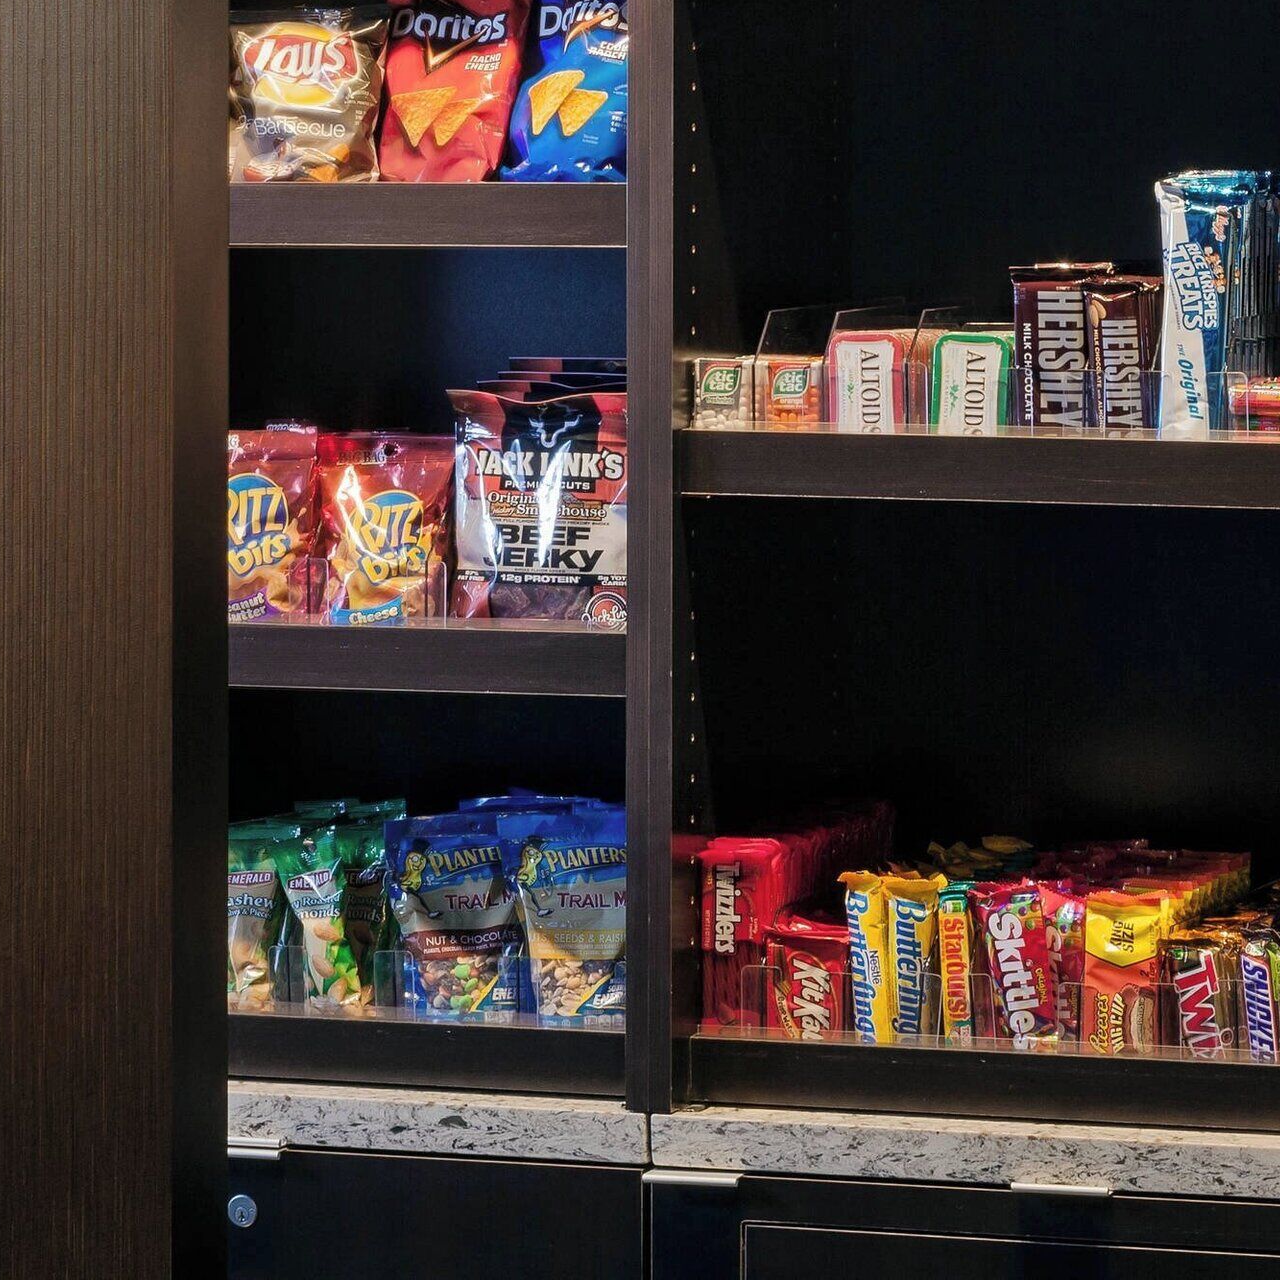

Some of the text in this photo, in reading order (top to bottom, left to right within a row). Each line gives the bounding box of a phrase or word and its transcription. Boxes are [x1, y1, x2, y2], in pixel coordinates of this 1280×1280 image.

[392, 9, 506, 43] Doritos
[464, 61, 502, 72] CHEESE
[469, 52, 502, 64] NACHO
[254, 116, 346, 138] Barbecue
[1170, 241, 1204, 331] TREATS
[1186, 242, 1220, 330] RICE KRISPIES
[1023, 322, 1035, 421] MILK CHOCOLATE
[1037, 290, 1086, 428] HERSHEY
[1101, 319, 1144, 429] HERSHEY
[709, 380, 734, 392] tac
[714, 370, 734, 382] tic
[779, 380, 804, 393] tac
[785, 371, 806, 383] tic
[1178, 358, 1204, 421] Original
[362, 451, 386, 464] BAG
[475, 447, 625, 481] JACK LNK'S
[349, 501, 424, 556] RITZ
[495, 524, 591, 546] BEEF
[229, 534, 288, 576] bits
[360, 546, 426, 585] bits
[482, 546, 605, 573] JERKY
[500, 573, 581, 584] 12g PROTEIN
[348, 604, 399, 625] Cheese
[544, 845, 627, 872] PLANTERS
[557, 892, 611, 909] TRAIL
[714, 861, 742, 955] Twizzlers
[425, 935, 457, 947] NUT &
[554, 933, 584, 943] SEEDS
[1109, 920, 1124, 950] KING
[1122, 922, 1135, 953] SIZE
[845, 891, 877, 1046] Butterfinge
[943, 918, 969, 1021] Starburst
[987, 912, 1040, 1051] Skittles
[1139, 970, 1150, 978] 2
[1109, 992, 1127, 1054] BIG CUP
